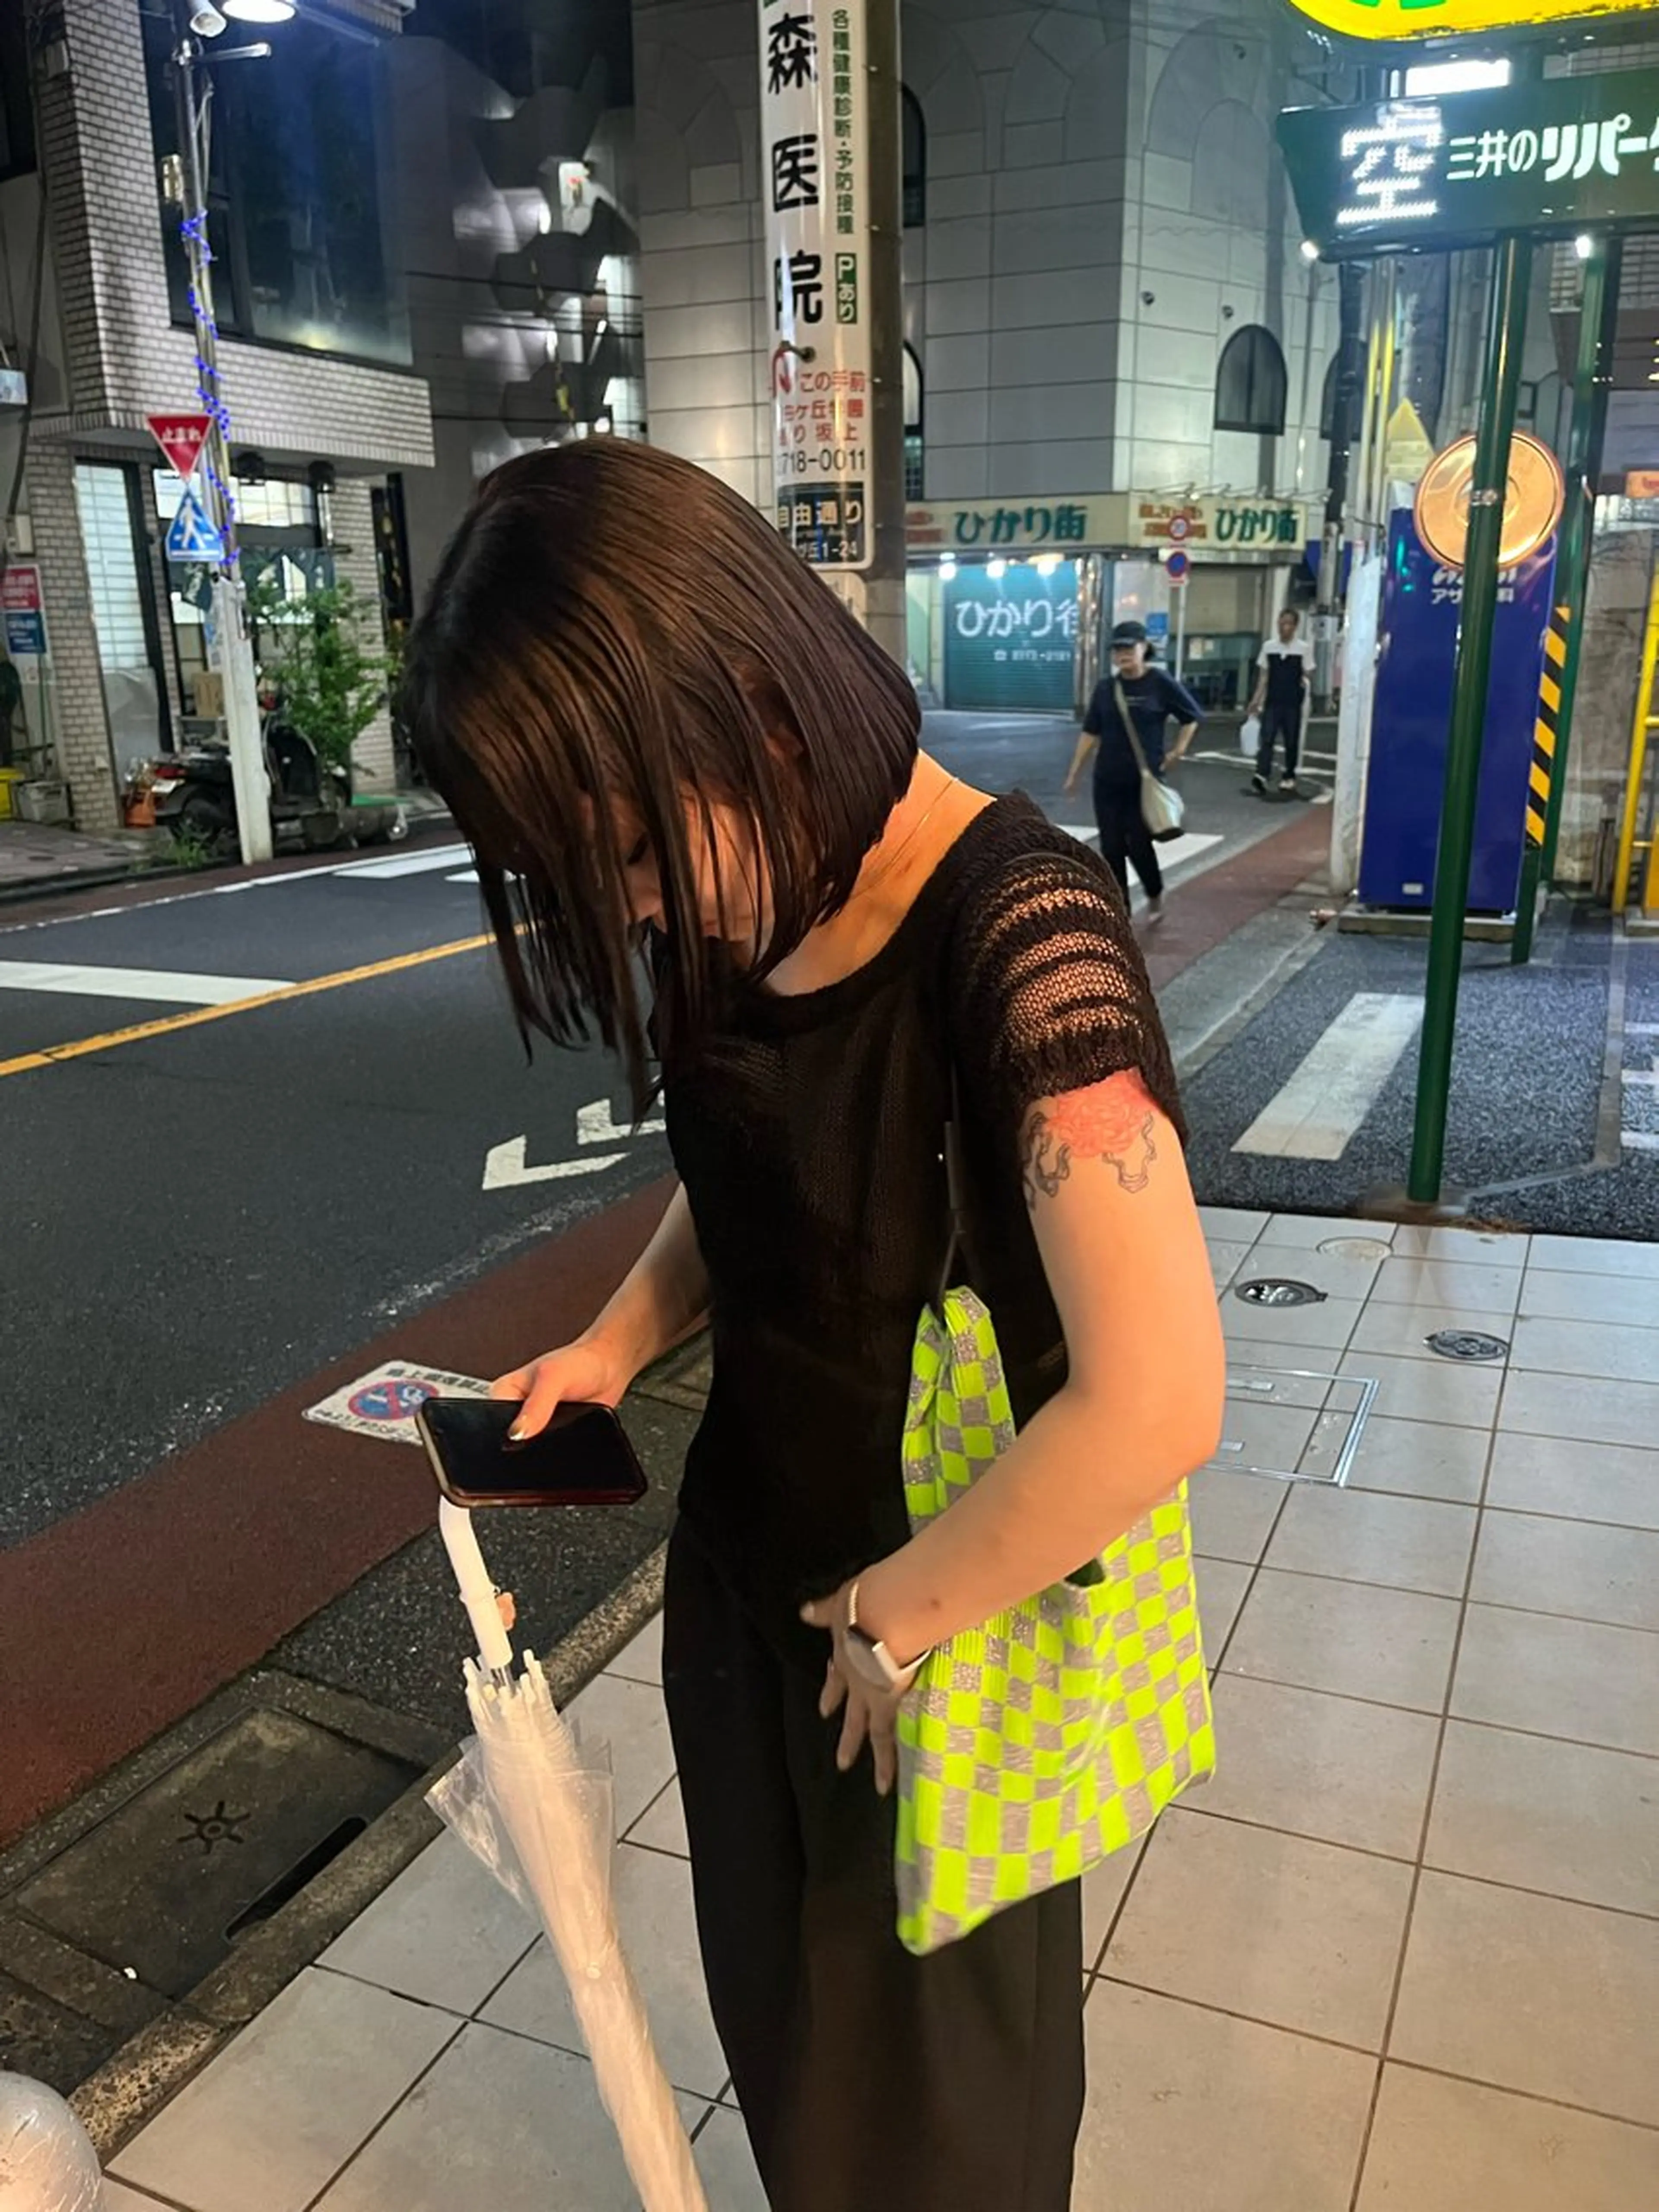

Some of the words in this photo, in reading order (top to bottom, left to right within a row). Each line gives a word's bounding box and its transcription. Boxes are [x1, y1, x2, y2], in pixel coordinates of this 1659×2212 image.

[768, 13, 823, 331] 森医院
[1336, 102, 1442, 225] 空
[1446, 112, 1659, 182] 三井のリパー
[800, 371, 866, 393] この手前
[953, 505, 1087, 545] ひかり街
